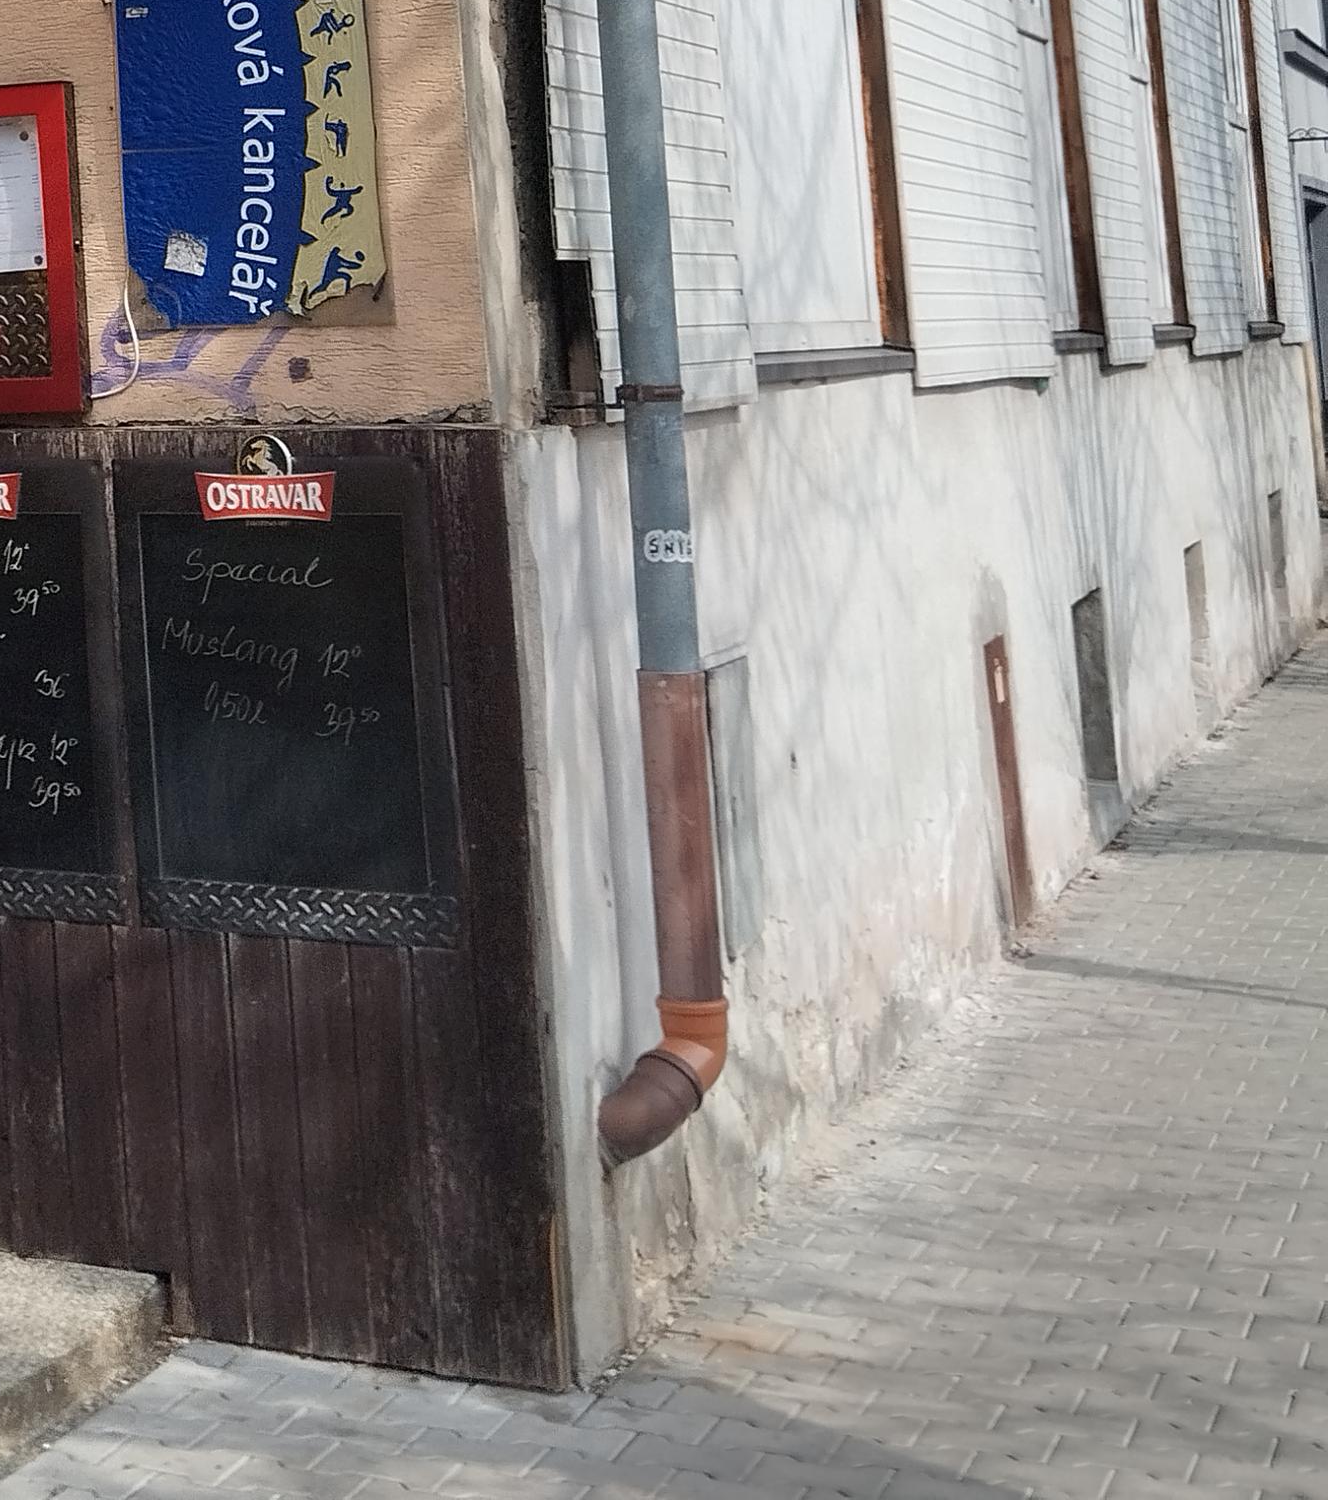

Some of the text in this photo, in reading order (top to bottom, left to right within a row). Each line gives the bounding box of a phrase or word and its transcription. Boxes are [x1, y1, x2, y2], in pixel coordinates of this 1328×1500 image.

[228, 105, 287, 317] kancelář
[206, 480, 322, 513] OSTRAVAR
[161, 617, 299, 695] Mustang
[33, 669, 70, 699] 36
